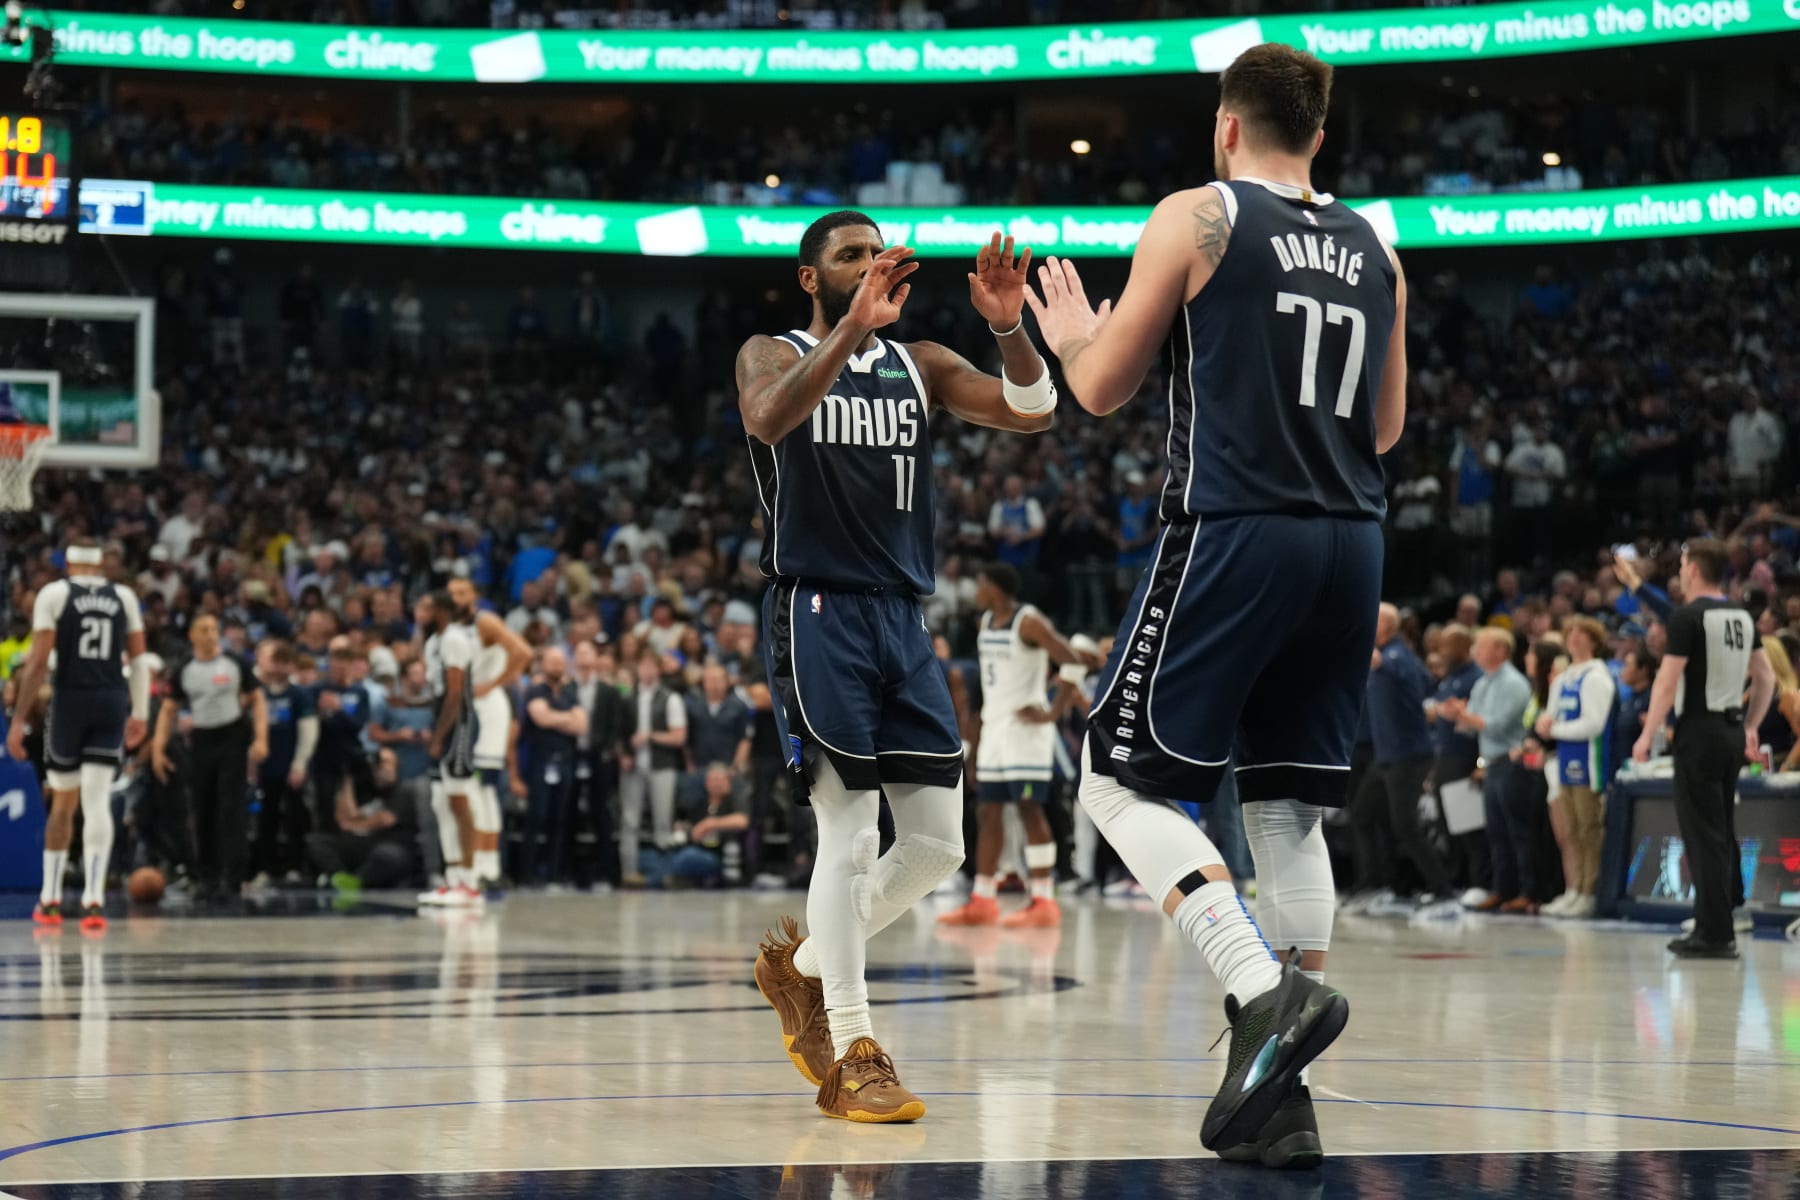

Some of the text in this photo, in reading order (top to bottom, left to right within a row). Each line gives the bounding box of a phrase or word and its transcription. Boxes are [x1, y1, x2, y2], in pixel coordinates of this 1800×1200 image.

[139, 26, 192, 58] the
[198, 28, 295, 67] hoops
[1301, 24, 1374, 55] Your
[1380, 23, 1489, 52] money
[1494, 12, 1588, 42] minus
[1594, 4, 1647, 34] the
[1652, 0, 1750, 31] hoops
[324, 31, 437, 72] chime
[578, 40, 1018, 76] Your money minus the hoops
[1047, 29, 1158, 70] chime
[0, 221, 67, 244] ISSOT
[147, 199, 219, 232] oney
[223, 197, 316, 231] minus
[319, 200, 371, 232] the
[373, 202, 467, 241] hoops
[500, 203, 608, 244] chime
[1007, 215, 1060, 246] the
[1429, 206, 1500, 236] Your
[1505, 205, 1609, 236] money
[1613, 194, 1703, 228] minus
[1706, 188, 1758, 221] the
[1269, 232, 1364, 287] DONČIĆ
[877, 367, 908, 379] chime
[1276, 291, 1366, 418] 77
[813, 394, 918, 447] MAVS
[891, 454, 916, 512] 11
[79, 616, 113, 659] 21
[1110, 606, 1165, 762] MAVERICKS
